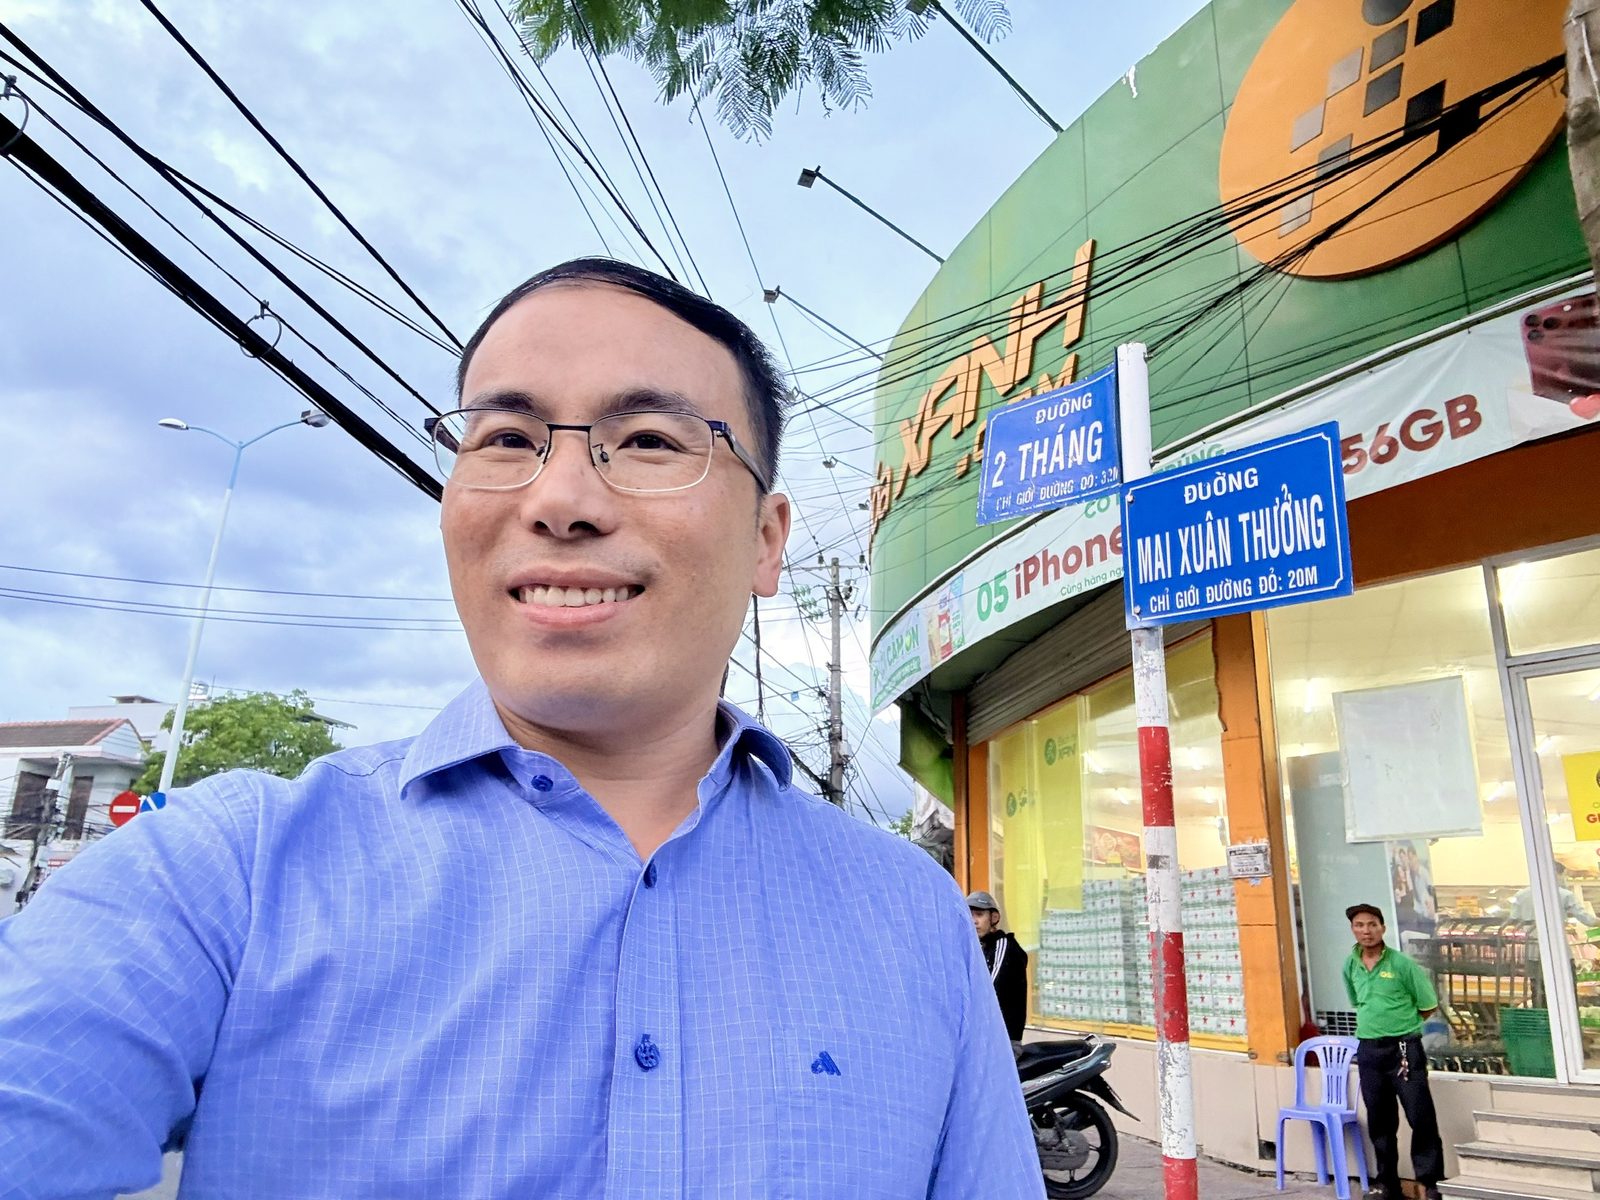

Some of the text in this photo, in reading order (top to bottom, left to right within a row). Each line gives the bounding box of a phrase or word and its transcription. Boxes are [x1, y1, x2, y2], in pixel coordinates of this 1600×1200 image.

[895, 238, 1096, 499] XANH
[991, 420, 1103, 489] 2 THÁNG
[976, 524, 1123, 622] 05 iPhone
[1136, 483, 1326, 585] MAI XUÂN THƯỞNG
[1150, 565, 1319, 613] CHỈ GIỚI ĐƯỜNG ĐỎ: 20M
